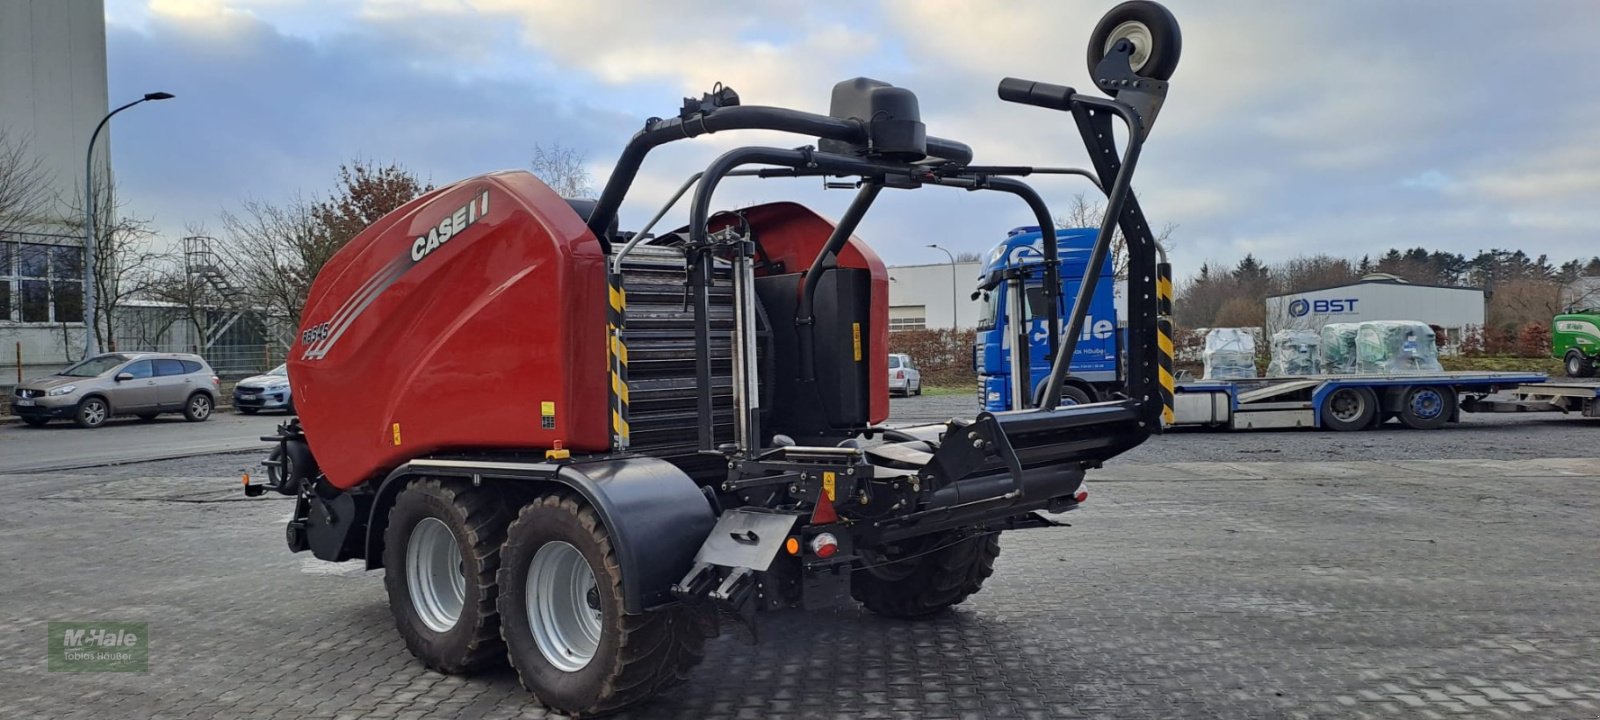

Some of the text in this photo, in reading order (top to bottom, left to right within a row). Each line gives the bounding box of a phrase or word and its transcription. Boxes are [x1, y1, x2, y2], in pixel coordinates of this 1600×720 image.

[411, 206, 467, 262] CASE
[1314, 299, 1359, 312] BST
[303, 322, 329, 345] RB545
